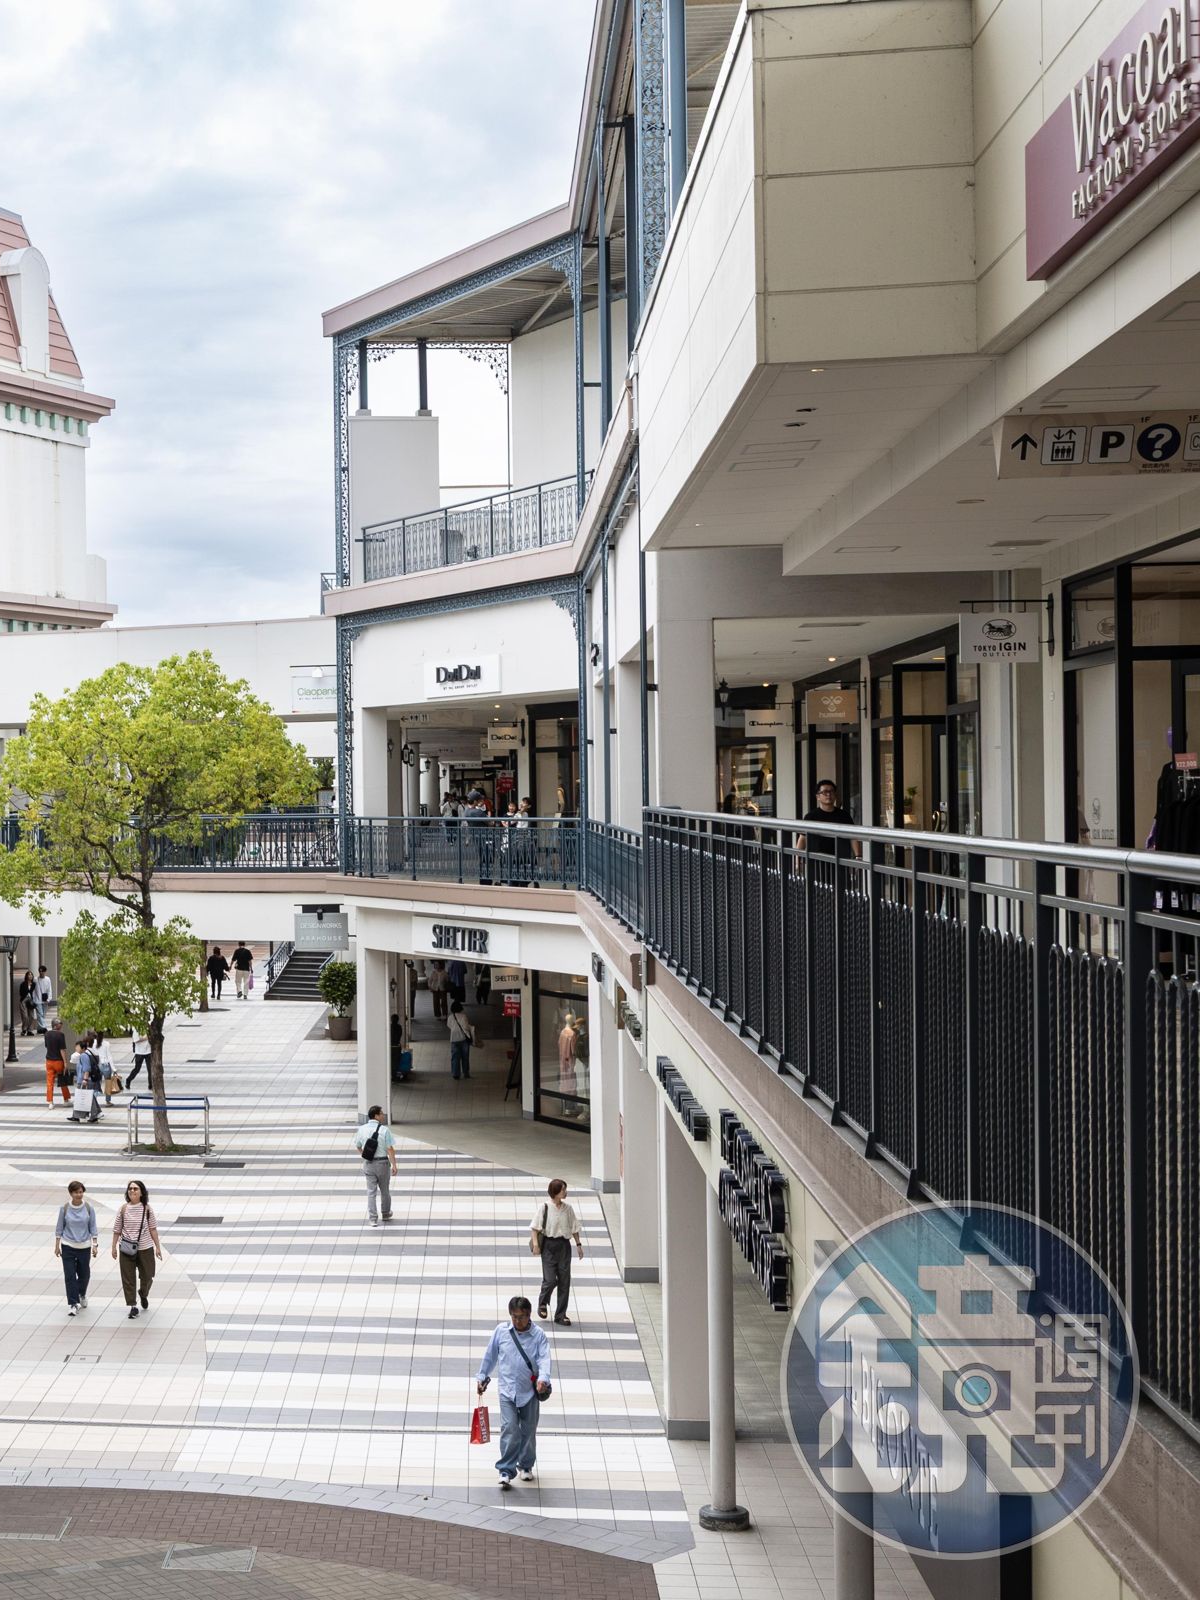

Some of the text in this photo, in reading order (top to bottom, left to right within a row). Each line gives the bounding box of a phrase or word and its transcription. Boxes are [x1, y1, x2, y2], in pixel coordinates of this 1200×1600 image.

[1070, 0, 1189, 173] Wacoal
[1071, 78, 1192, 219] FACTORY STORE
[1099, 430, 1126, 459] P
[999, 642, 1027, 651] IGIN
[818, 711, 846, 719] hummel
[479, 1408, 488, 1442] DIESEL
